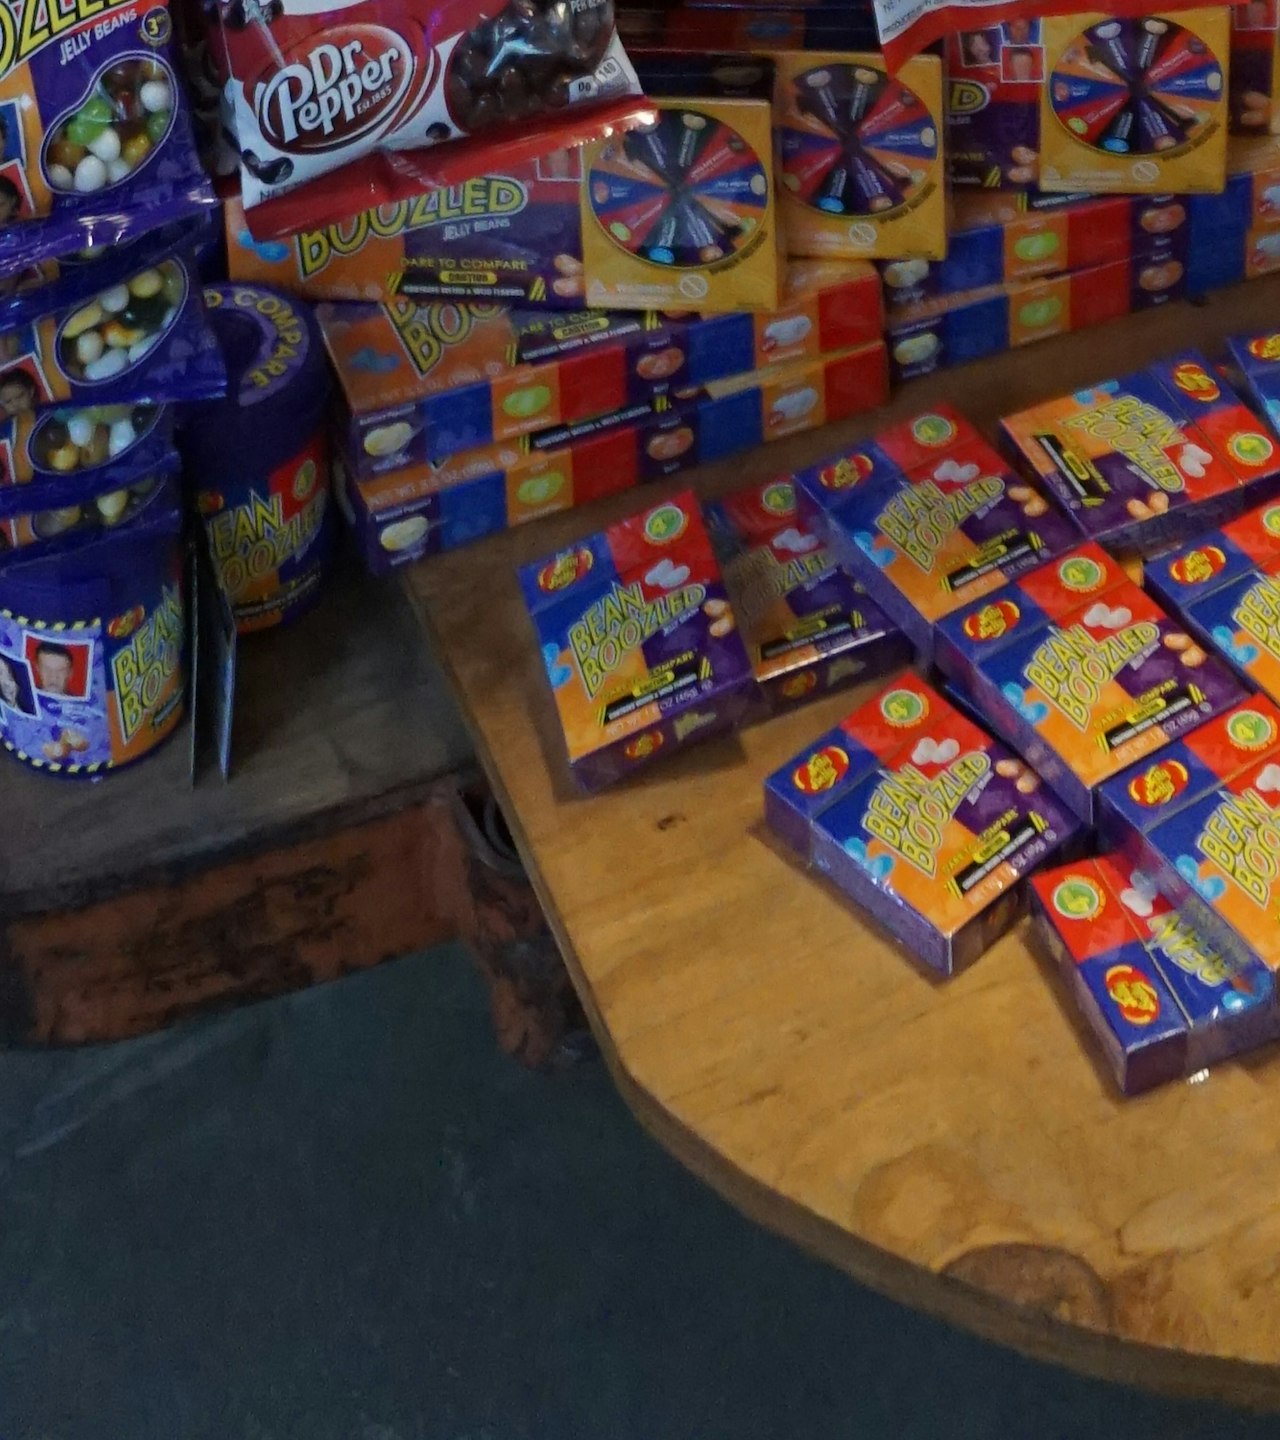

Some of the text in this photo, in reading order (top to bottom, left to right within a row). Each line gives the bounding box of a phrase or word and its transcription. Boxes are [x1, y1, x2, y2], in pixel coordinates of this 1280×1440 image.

[59, 9, 137, 66] JELLY BEANS
[308, 38, 364, 84] Dr
[273, 46, 401, 144] Pepper
[904, 476, 1006, 574] BOOZLED
[569, 580, 645, 660] BEAN
[584, 582, 707, 701] BOOZLED
[1024, 624, 1093, 700] BEAN
[1053, 620, 1161, 728] BOOZLED
[862, 763, 926, 850] BEAN
[901, 751, 992, 880] BOOZLED
[1195, 787, 1274, 878] BEAN
